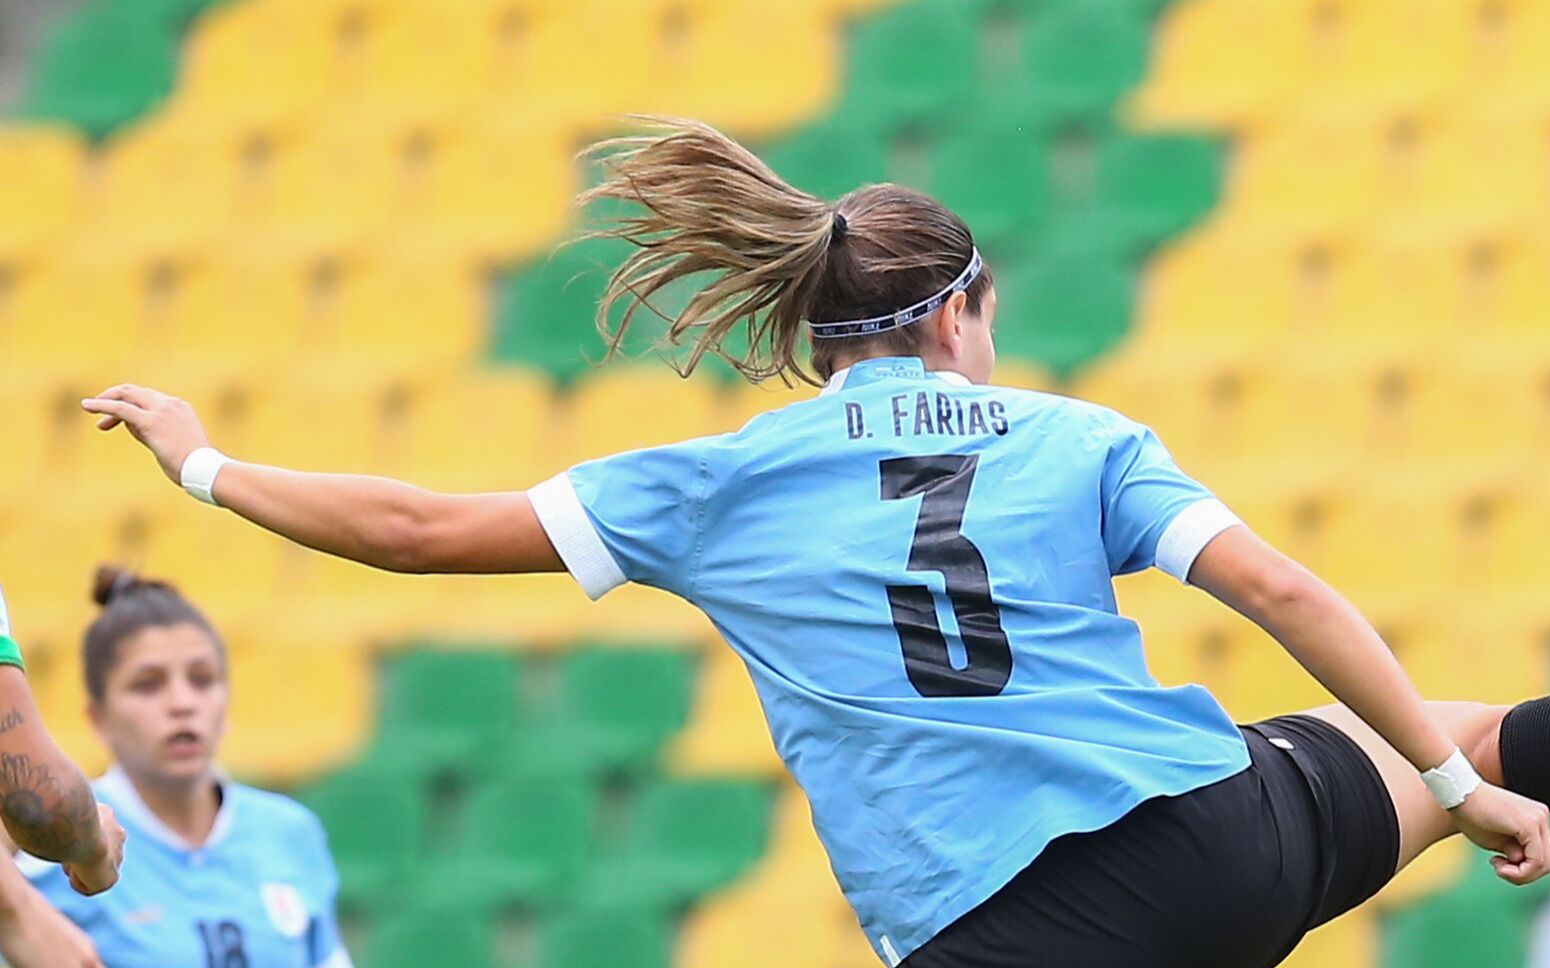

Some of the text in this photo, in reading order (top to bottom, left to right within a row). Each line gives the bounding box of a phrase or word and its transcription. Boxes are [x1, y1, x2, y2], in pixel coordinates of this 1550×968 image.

[844, 391, 1009, 440] D. FARIAS
[879, 453, 1014, 698] 3
